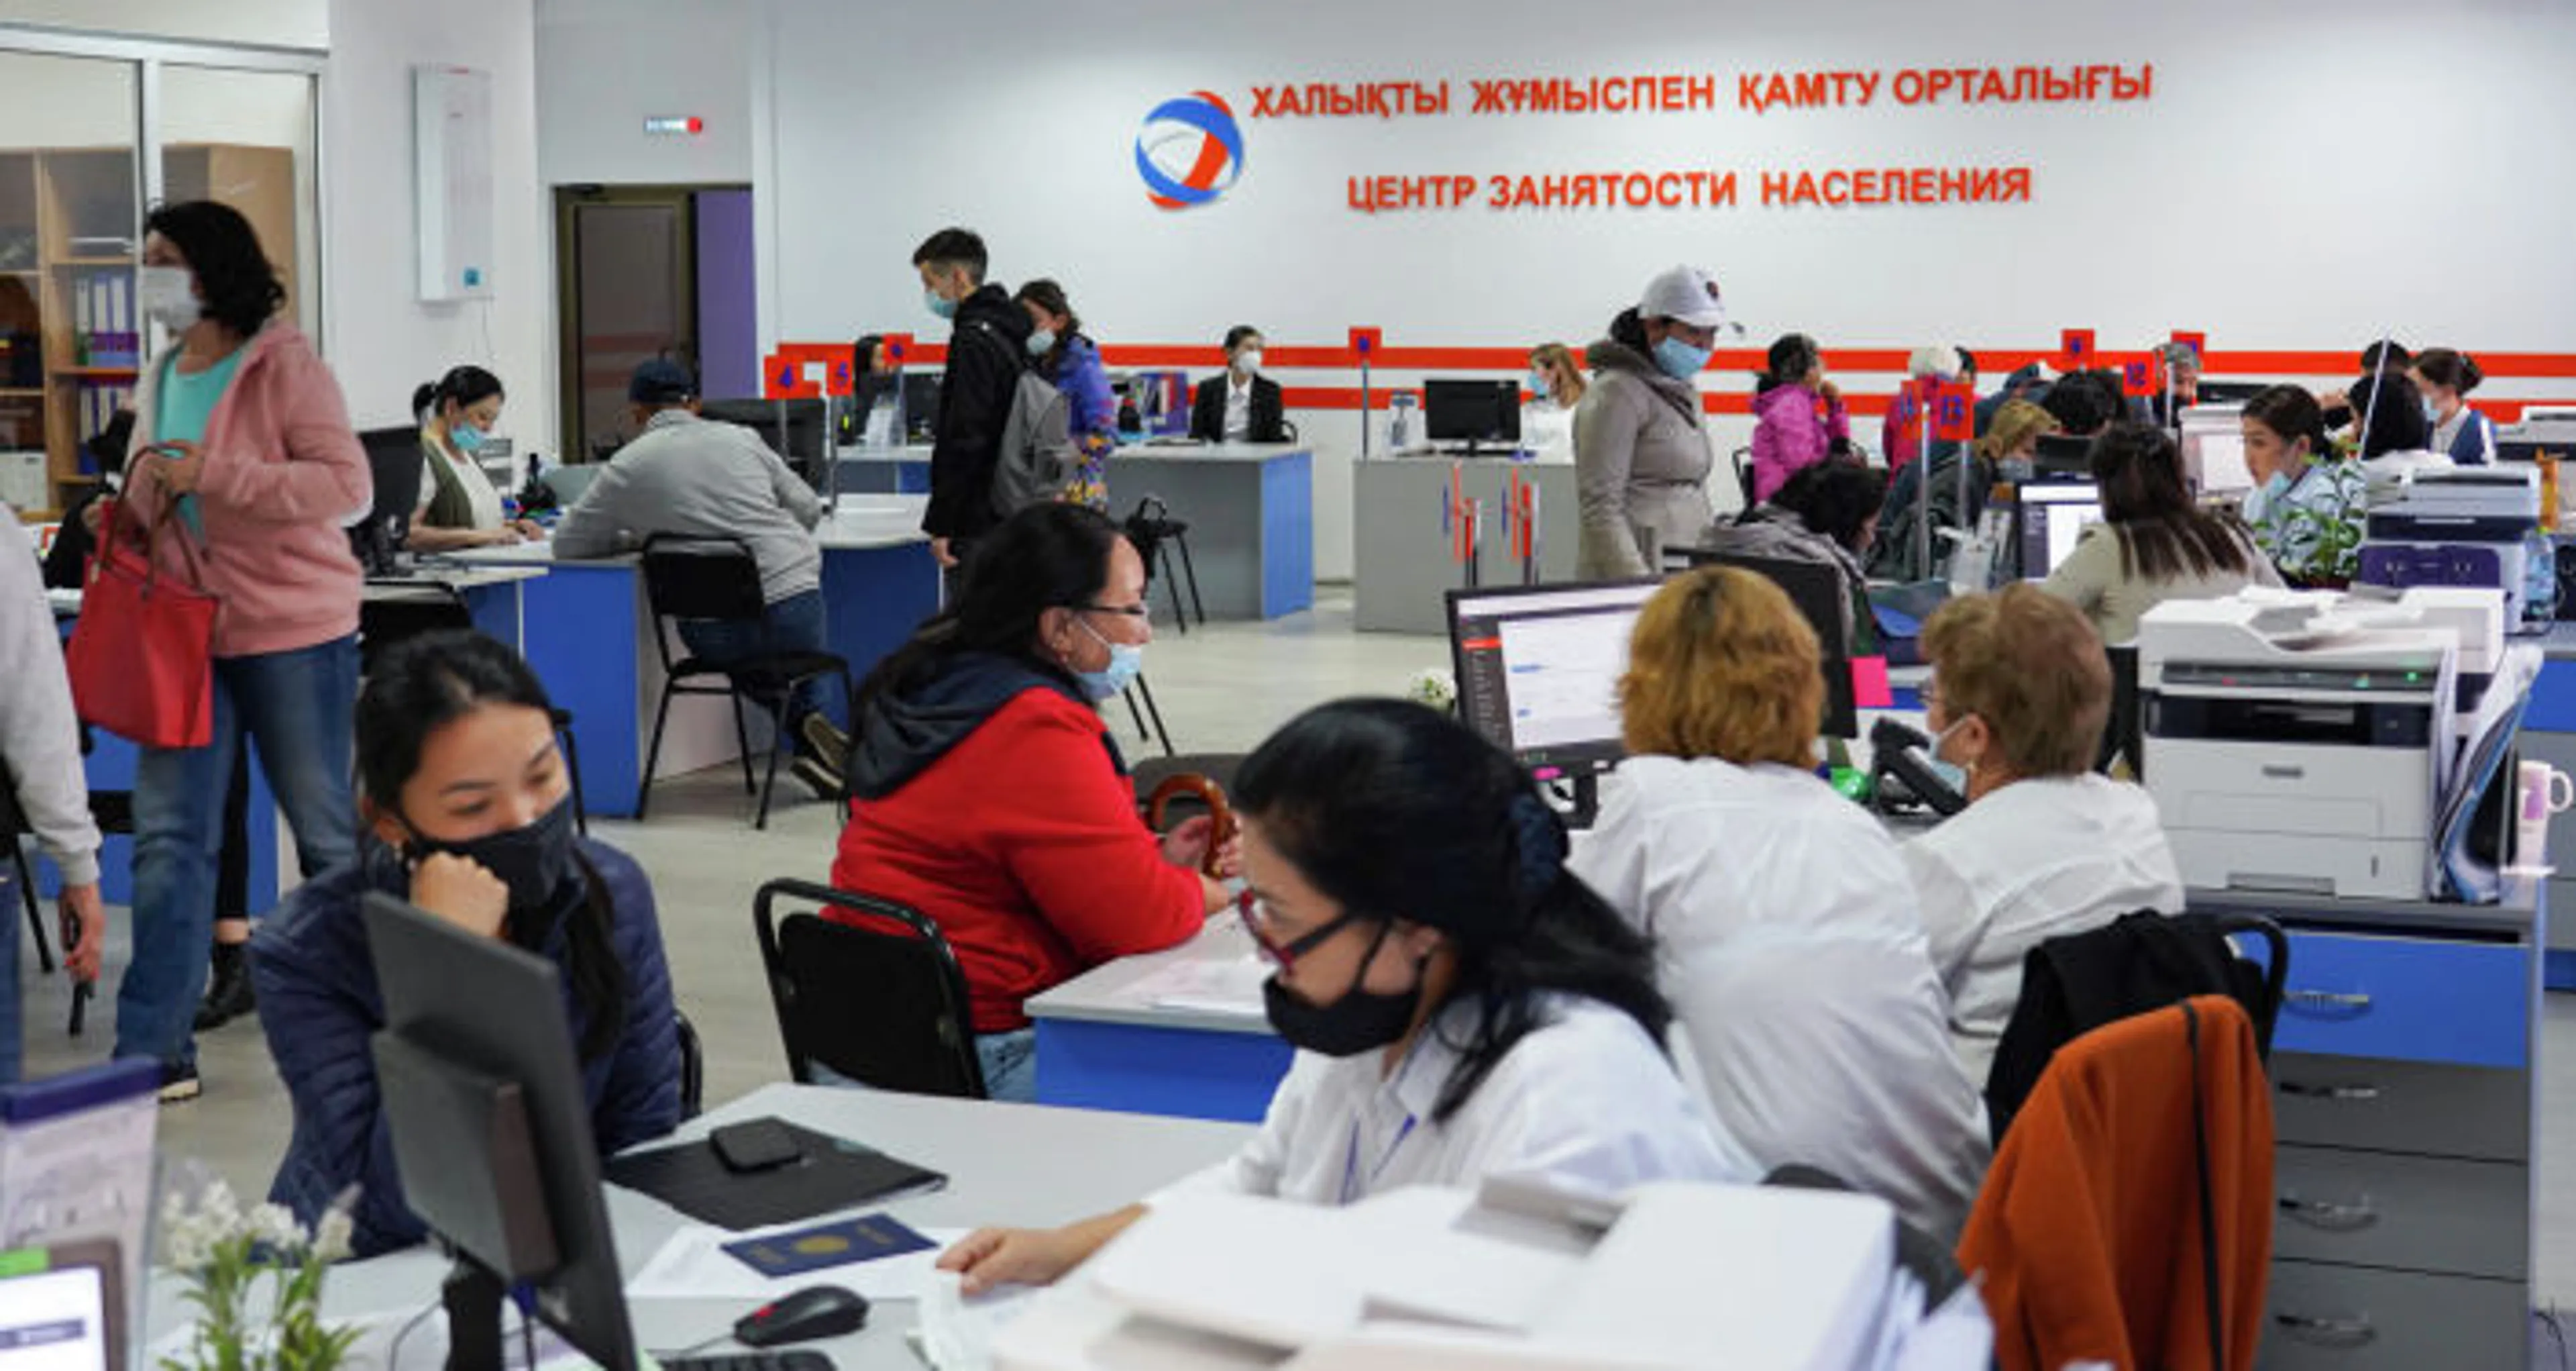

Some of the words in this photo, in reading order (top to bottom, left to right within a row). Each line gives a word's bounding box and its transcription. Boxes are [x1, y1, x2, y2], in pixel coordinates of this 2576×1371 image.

[1250, 80, 1450, 118] ХАЛЫҚТЫ
[1472, 73, 1715, 113] ЖҰМЫСПЕН
[1737, 70, 1880, 115] ҚАМТУ
[1892, 64, 2153, 105] ОРТАЛЫҒЫ
[1347, 174, 1477, 214] ЦЕНТР
[1488, 170, 1737, 207] ЗАНЯТОСТИ
[1761, 166, 2032, 206] НАСЕЛЕНИЯ
[2127, 362, 2147, 387] 12
